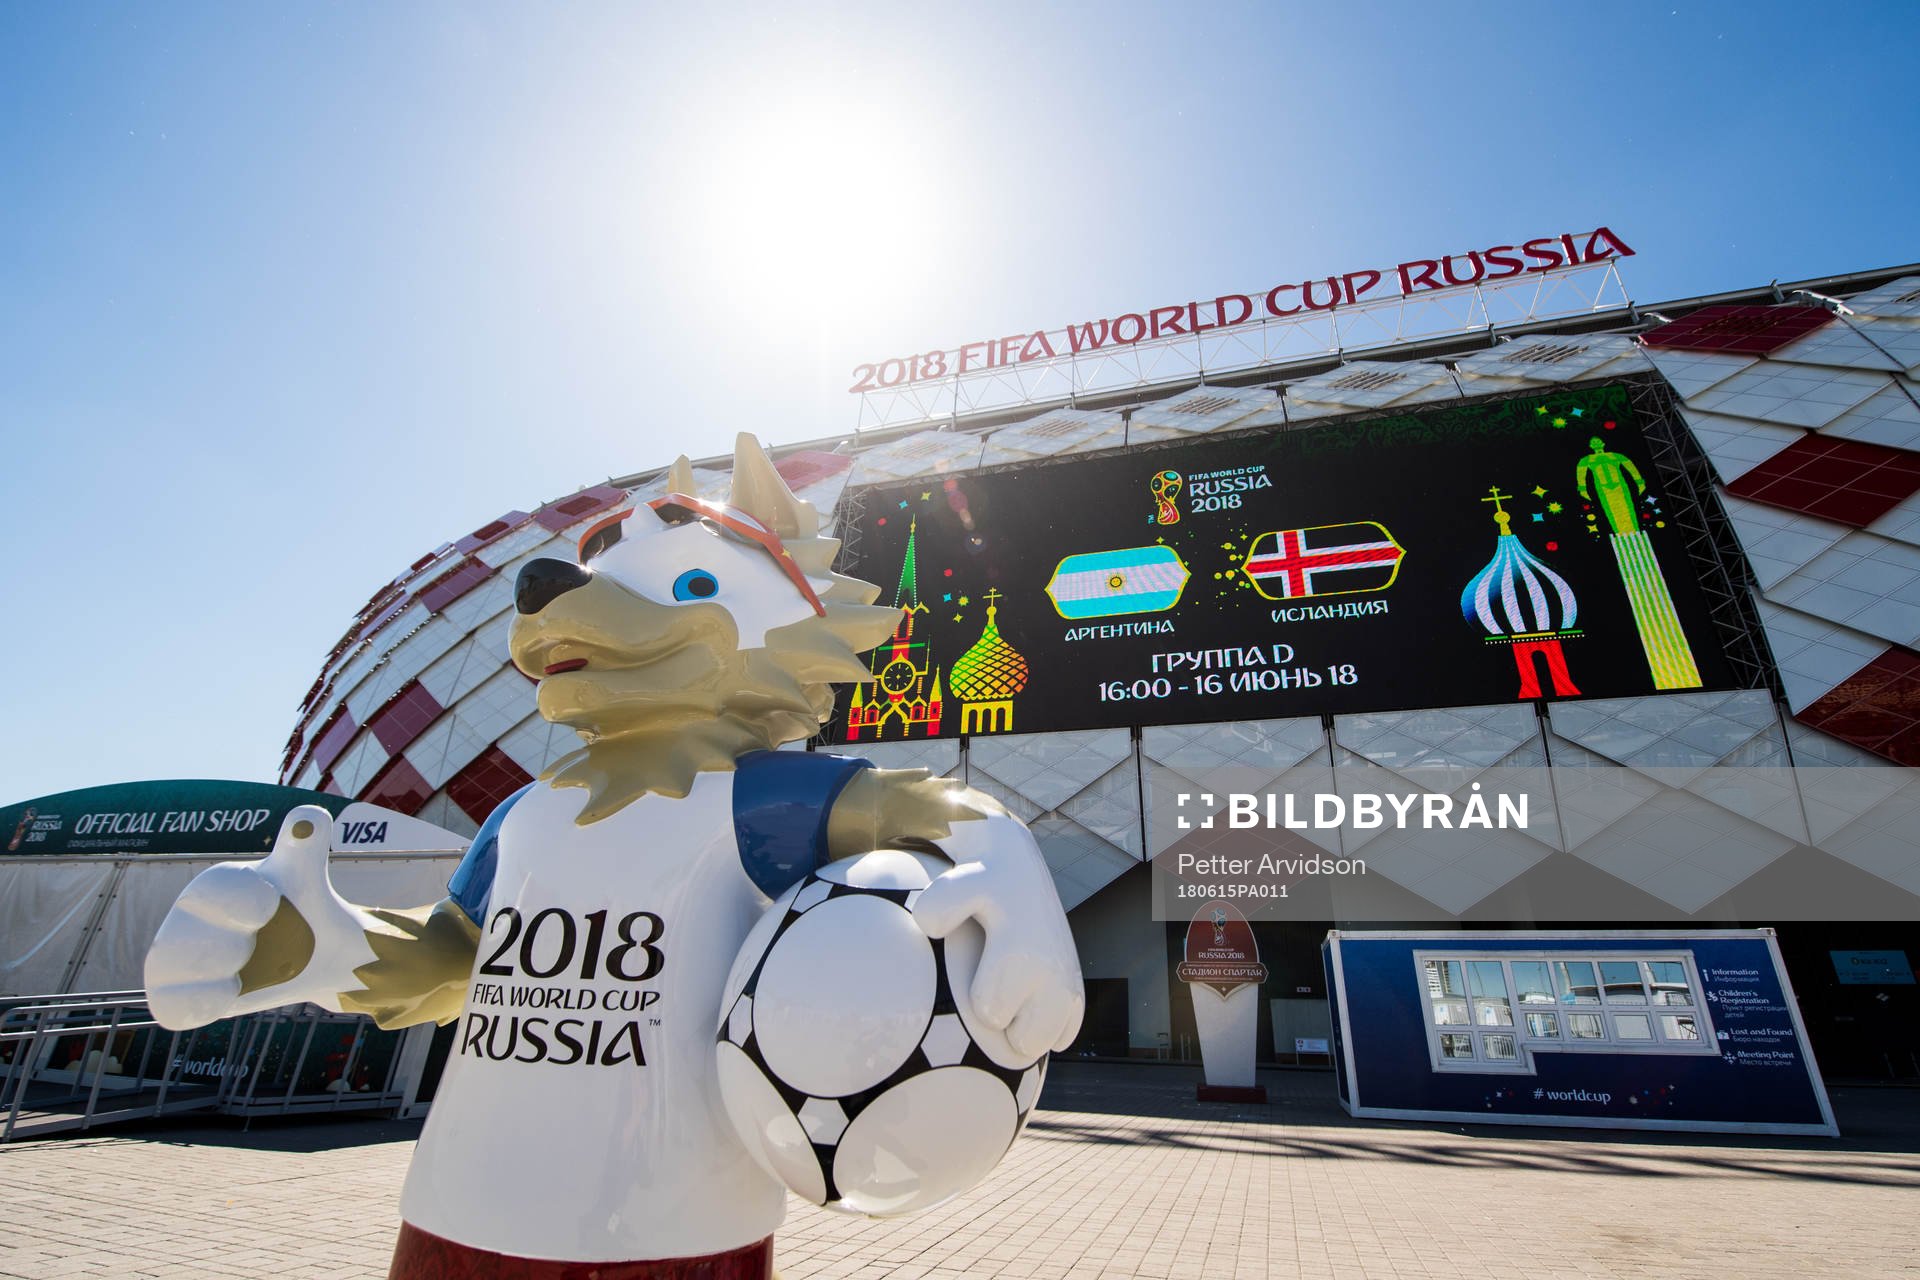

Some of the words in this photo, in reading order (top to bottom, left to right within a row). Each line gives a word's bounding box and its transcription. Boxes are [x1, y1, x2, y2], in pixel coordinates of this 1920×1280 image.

[849, 350, 947, 393] 2018
[958, 330, 1057, 374] FIFA
[1066, 294, 1253, 353] WORLD
[1265, 270, 1381, 317] CUP
[1397, 227, 1636, 294] RUSSIA
[1189, 473, 1209, 481] FIFA
[1210, 468, 1245, 478] WORLD
[1246, 465, 1265, 474] CUP
[1189, 474, 1273, 497] RUSSIA
[1191, 494, 1242, 513] 2018
[1271, 600, 1389, 623] ИСЛАНДИЯ
[1064, 619, 1175, 641] АРГЕНТИНА
[1152, 645, 1267, 673] ГРУППА
[1273, 643, 1294, 664] D
[1098, 678, 1171, 701] 16:00
[1195, 674, 1223, 695] 16
[1229, 668, 1322, 692] ИЮНЬ
[1328, 664, 1358, 686] 18
[75, 812, 156, 834] OFFICIAL
[158, 811, 204, 833] FAN
[205, 809, 270, 832] SHOP
[341, 821, 388, 844] VISA
[479, 906, 665, 982] 2018
[1227, 952, 1245, 960] 2018
[1182, 968, 1221, 977] СТАДИОН
[1223, 968, 1262, 977] СПАРТАК
[1711, 968, 1759, 976] Information
[472, 983, 504, 1006] FIFA
[510, 986, 597, 1010] WORLD
[602, 989, 661, 1012] CUP
[1718, 989, 1758, 997] Children's
[1720, 997, 1770, 1005] Registration
[461, 1012, 647, 1067] RUSSIA
[1730, 1027, 1749, 1035] Lost
[1749, 1028, 1766, 1036] and
[1766, 1028, 1793, 1036] Found
[1737, 1050, 1772, 1059] Meeting
[1772, 1051, 1794, 1059] Point
